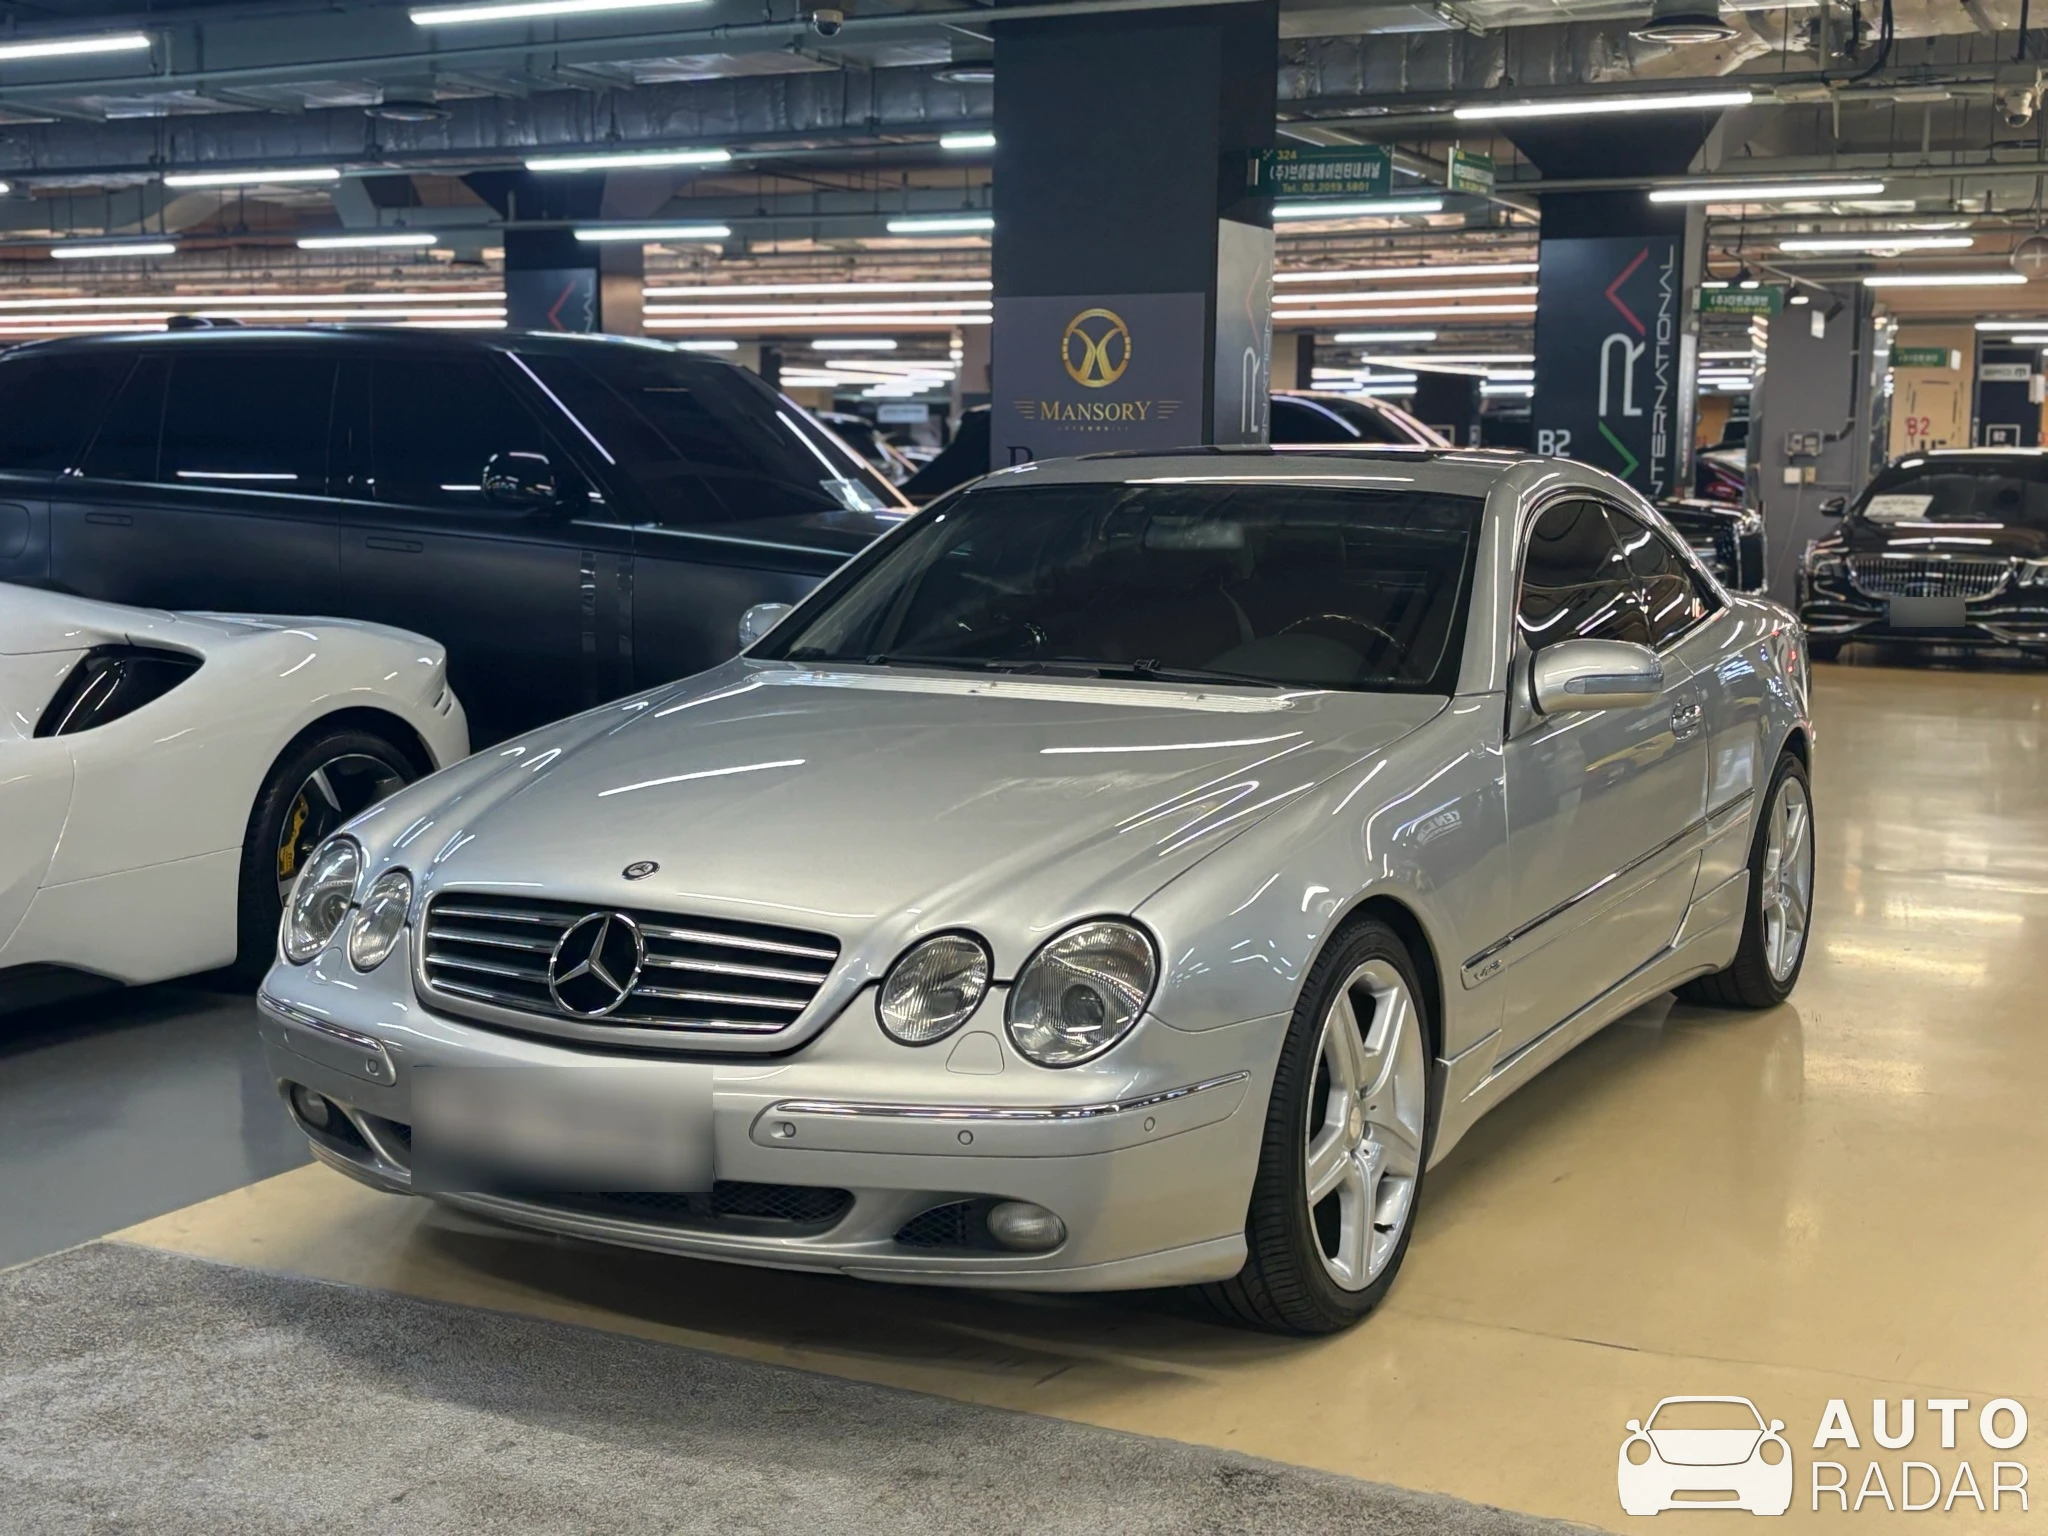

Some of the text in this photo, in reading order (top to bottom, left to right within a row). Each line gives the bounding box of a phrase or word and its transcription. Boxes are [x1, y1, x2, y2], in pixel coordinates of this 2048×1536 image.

[1650, 244, 1675, 497] NTERNATIONAL
[1040, 401, 1152, 421] MANSORY
[1906, 416, 1930, 436] B2
[1538, 430, 1571, 457] B2
